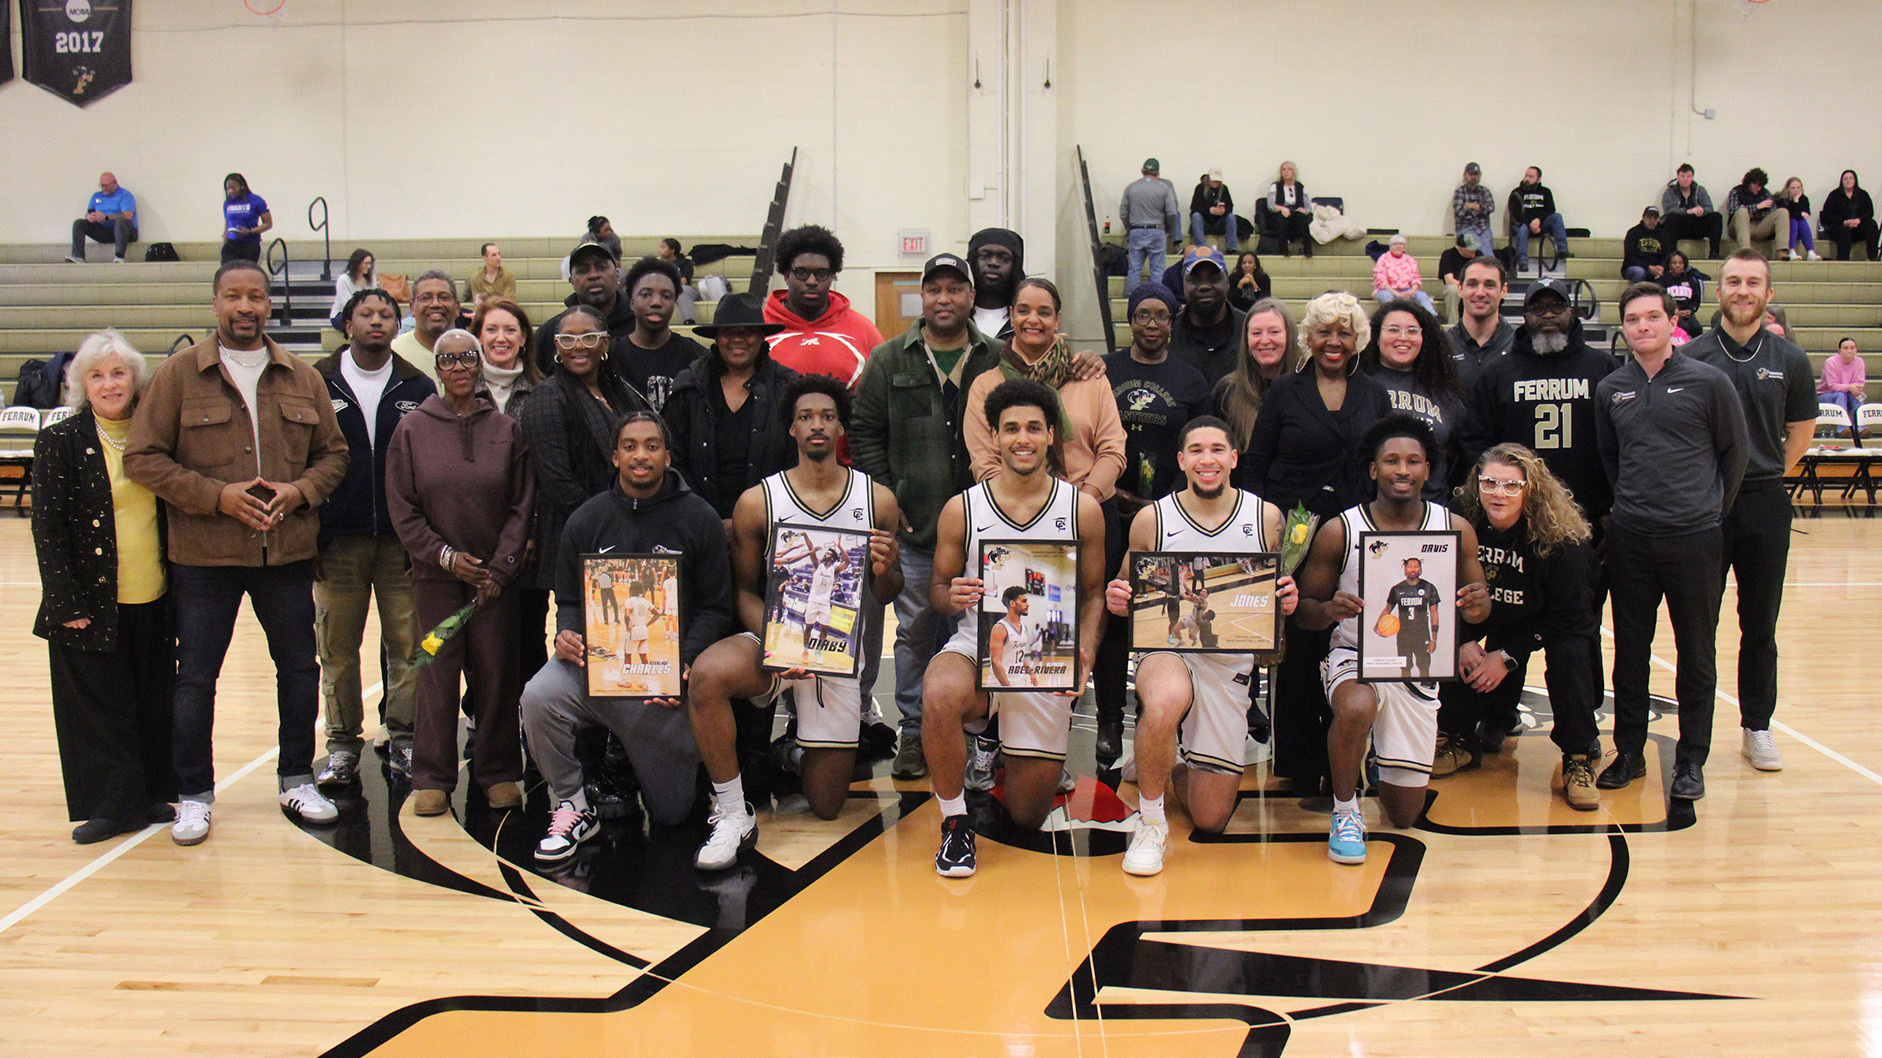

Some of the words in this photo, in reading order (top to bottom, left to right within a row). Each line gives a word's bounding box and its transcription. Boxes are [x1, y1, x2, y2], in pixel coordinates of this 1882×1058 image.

[69, 8, 90, 16] NCAA
[55, 31, 104, 53] 2017
[903, 237, 924, 251] EXIT
[1514, 378, 1588, 402] FERRUM
[2, 411, 36, 423] FERRUM
[1535, 402, 1572, 449] 21
[1421, 544, 1448, 553] DAVIS
[1230, 595, 1269, 608] JONES
[1408, 606, 1415, 620] 3
[807, 637, 847, 653] DIABY
[1014, 649, 1024, 664] 12
[622, 663, 671, 675] CHARLES
[1007, 665, 1067, 675] ABEL-RIVERA
